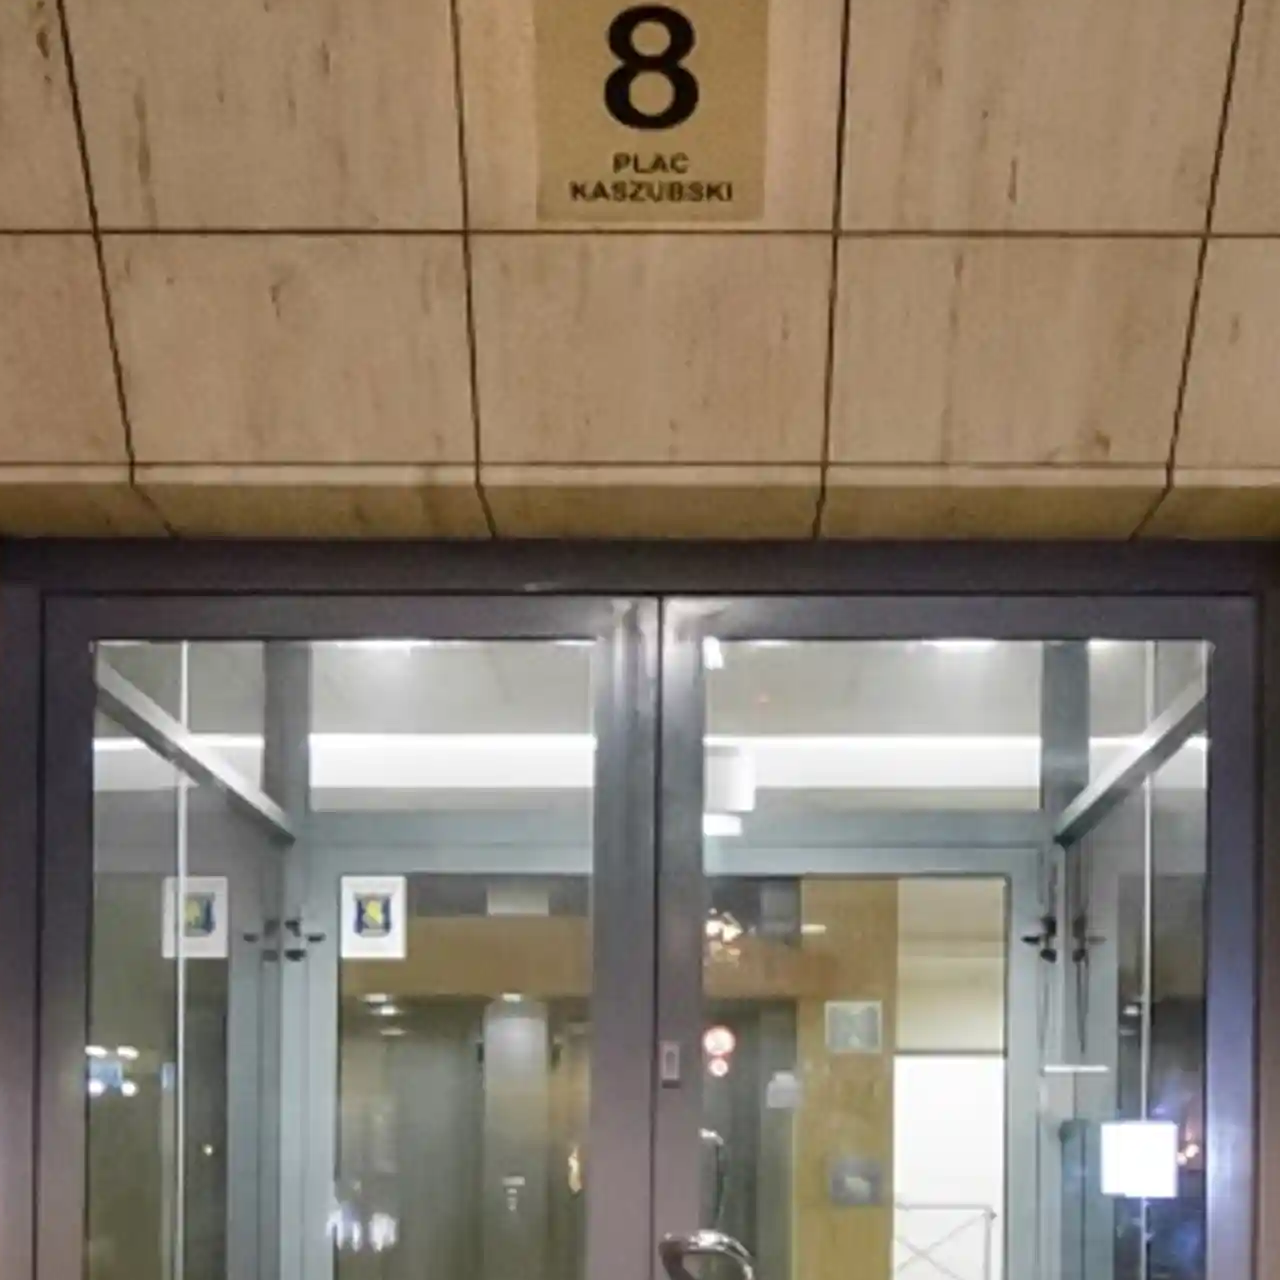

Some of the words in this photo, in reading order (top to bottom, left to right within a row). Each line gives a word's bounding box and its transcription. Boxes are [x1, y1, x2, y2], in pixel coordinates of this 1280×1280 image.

[604, 4, 699, 130] 8
[612, 152, 690, 174] PLAC
[570, 179, 734, 203] KASZUBSKI
